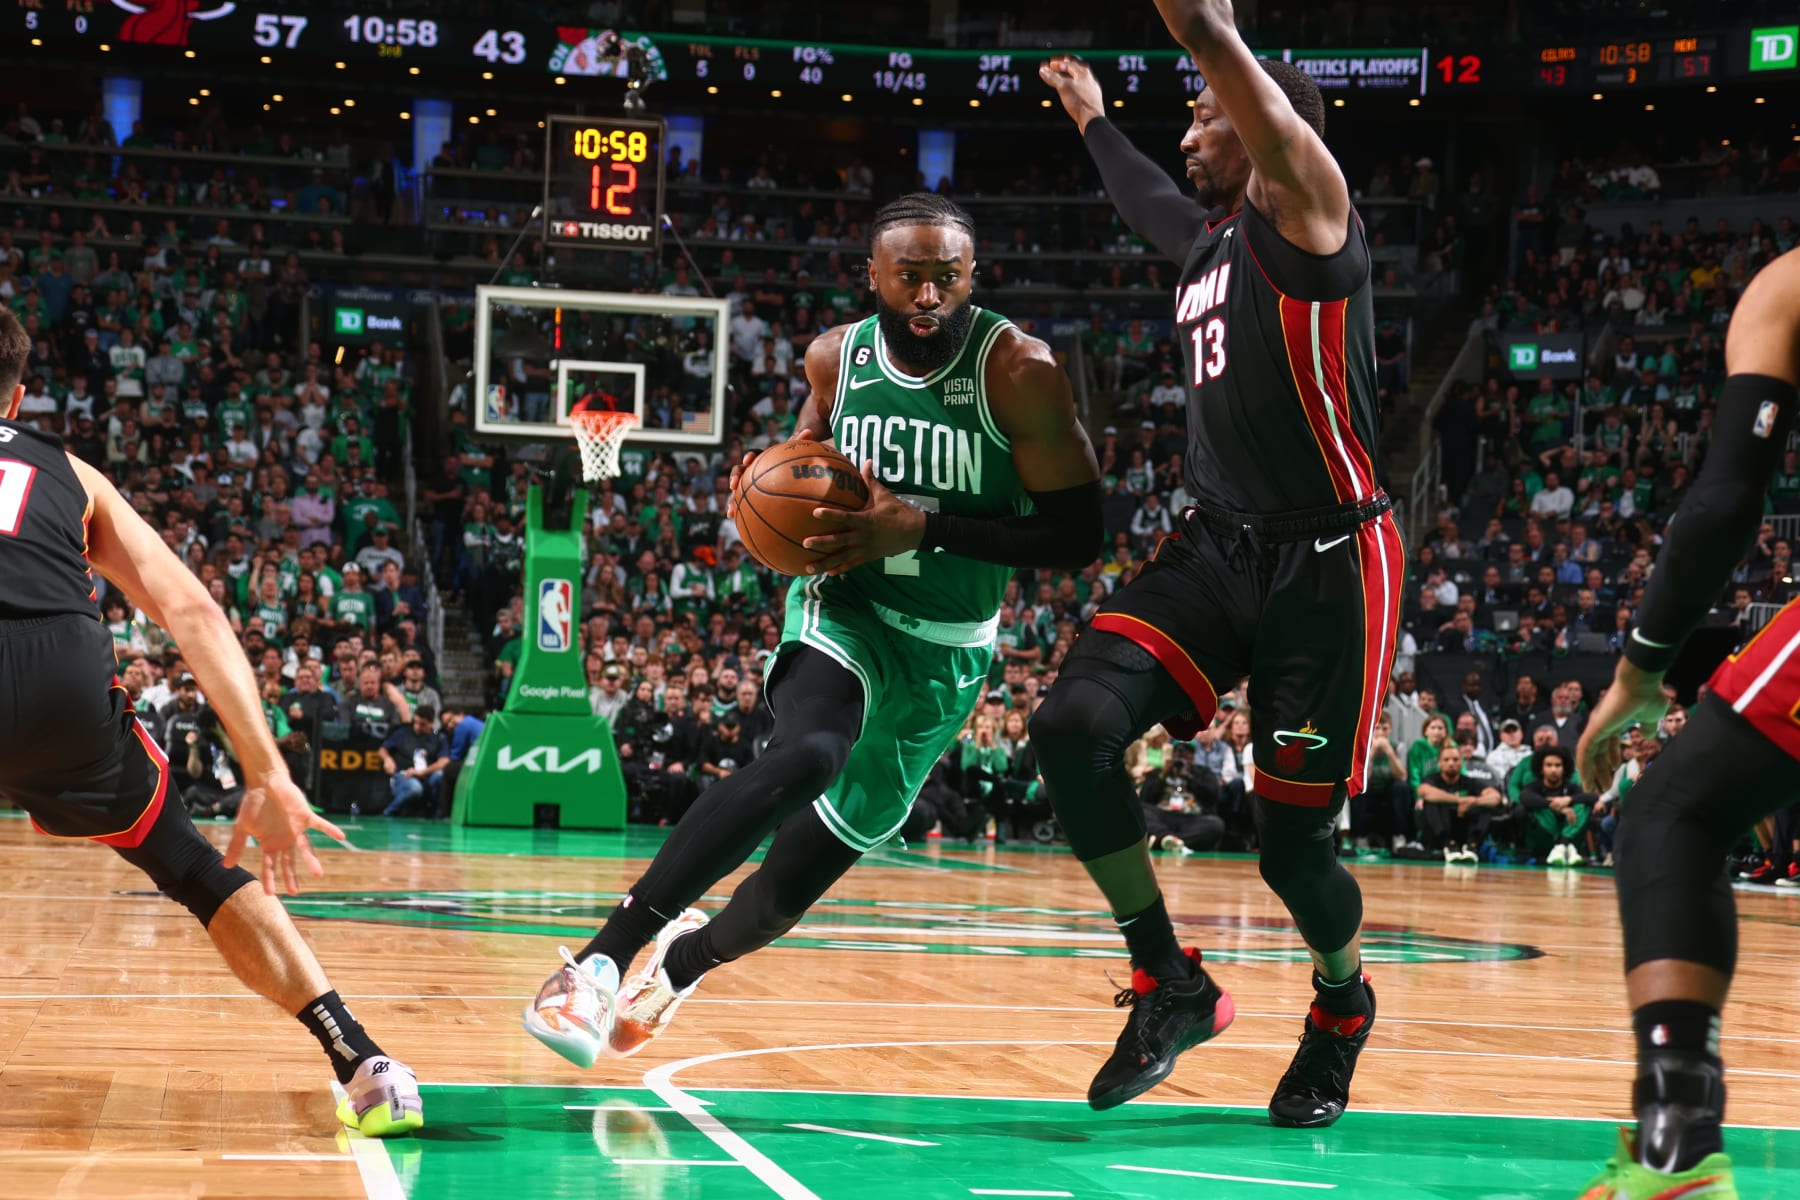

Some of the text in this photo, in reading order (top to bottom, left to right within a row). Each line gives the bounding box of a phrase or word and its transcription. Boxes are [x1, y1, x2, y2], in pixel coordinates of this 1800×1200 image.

[25, 12, 38, 29] 5
[75, 15, 88, 34] 0
[253, 13, 308, 48] 57
[343, 15, 438, 47] 10:58
[378, 43, 403, 58] 3rd
[472, 29, 527, 64] 43
[793, 46, 834, 64] FG%
[1600, 43, 1651, 65] 10:58
[1755, 34, 1794, 61] TD
[696, 60, 708, 77] 5
[888, 52, 912, 69] FG
[978, 55, 1011, 71] 3PT
[1118, 55, 1148, 71] STL
[1175, 55, 1200, 71] AS
[1295, 57, 1419, 76] CELTICS PLAYOFFS
[1437, 55, 1481, 83] 12
[1683, 56, 1709, 76] 57
[743, 63, 755, 80] 0
[800, 66, 823, 84] 40
[1540, 66, 1565, 86] 43
[1627, 67, 1637, 84] 3
[873, 71, 926, 93] 18/45
[976, 74, 1020, 96] 4/21
[1127, 75, 1139, 92] 2
[574, 128, 647, 162] 10:58
[591, 163, 637, 215] 12
[578, 222, 652, 241] TISSOT
[1176, 261, 1231, 324] AMI
[338, 312, 402, 331] TD Bank
[856, 348, 871, 365] 6
[1192, 316, 1226, 388] 13
[1512, 348, 1576, 365] TD Bank
[943, 378, 975, 394] VISTA
[943, 393, 975, 406] PRINT
[840, 414, 982, 495] BOSTON
[519, 684, 586, 699] Google Pixel
